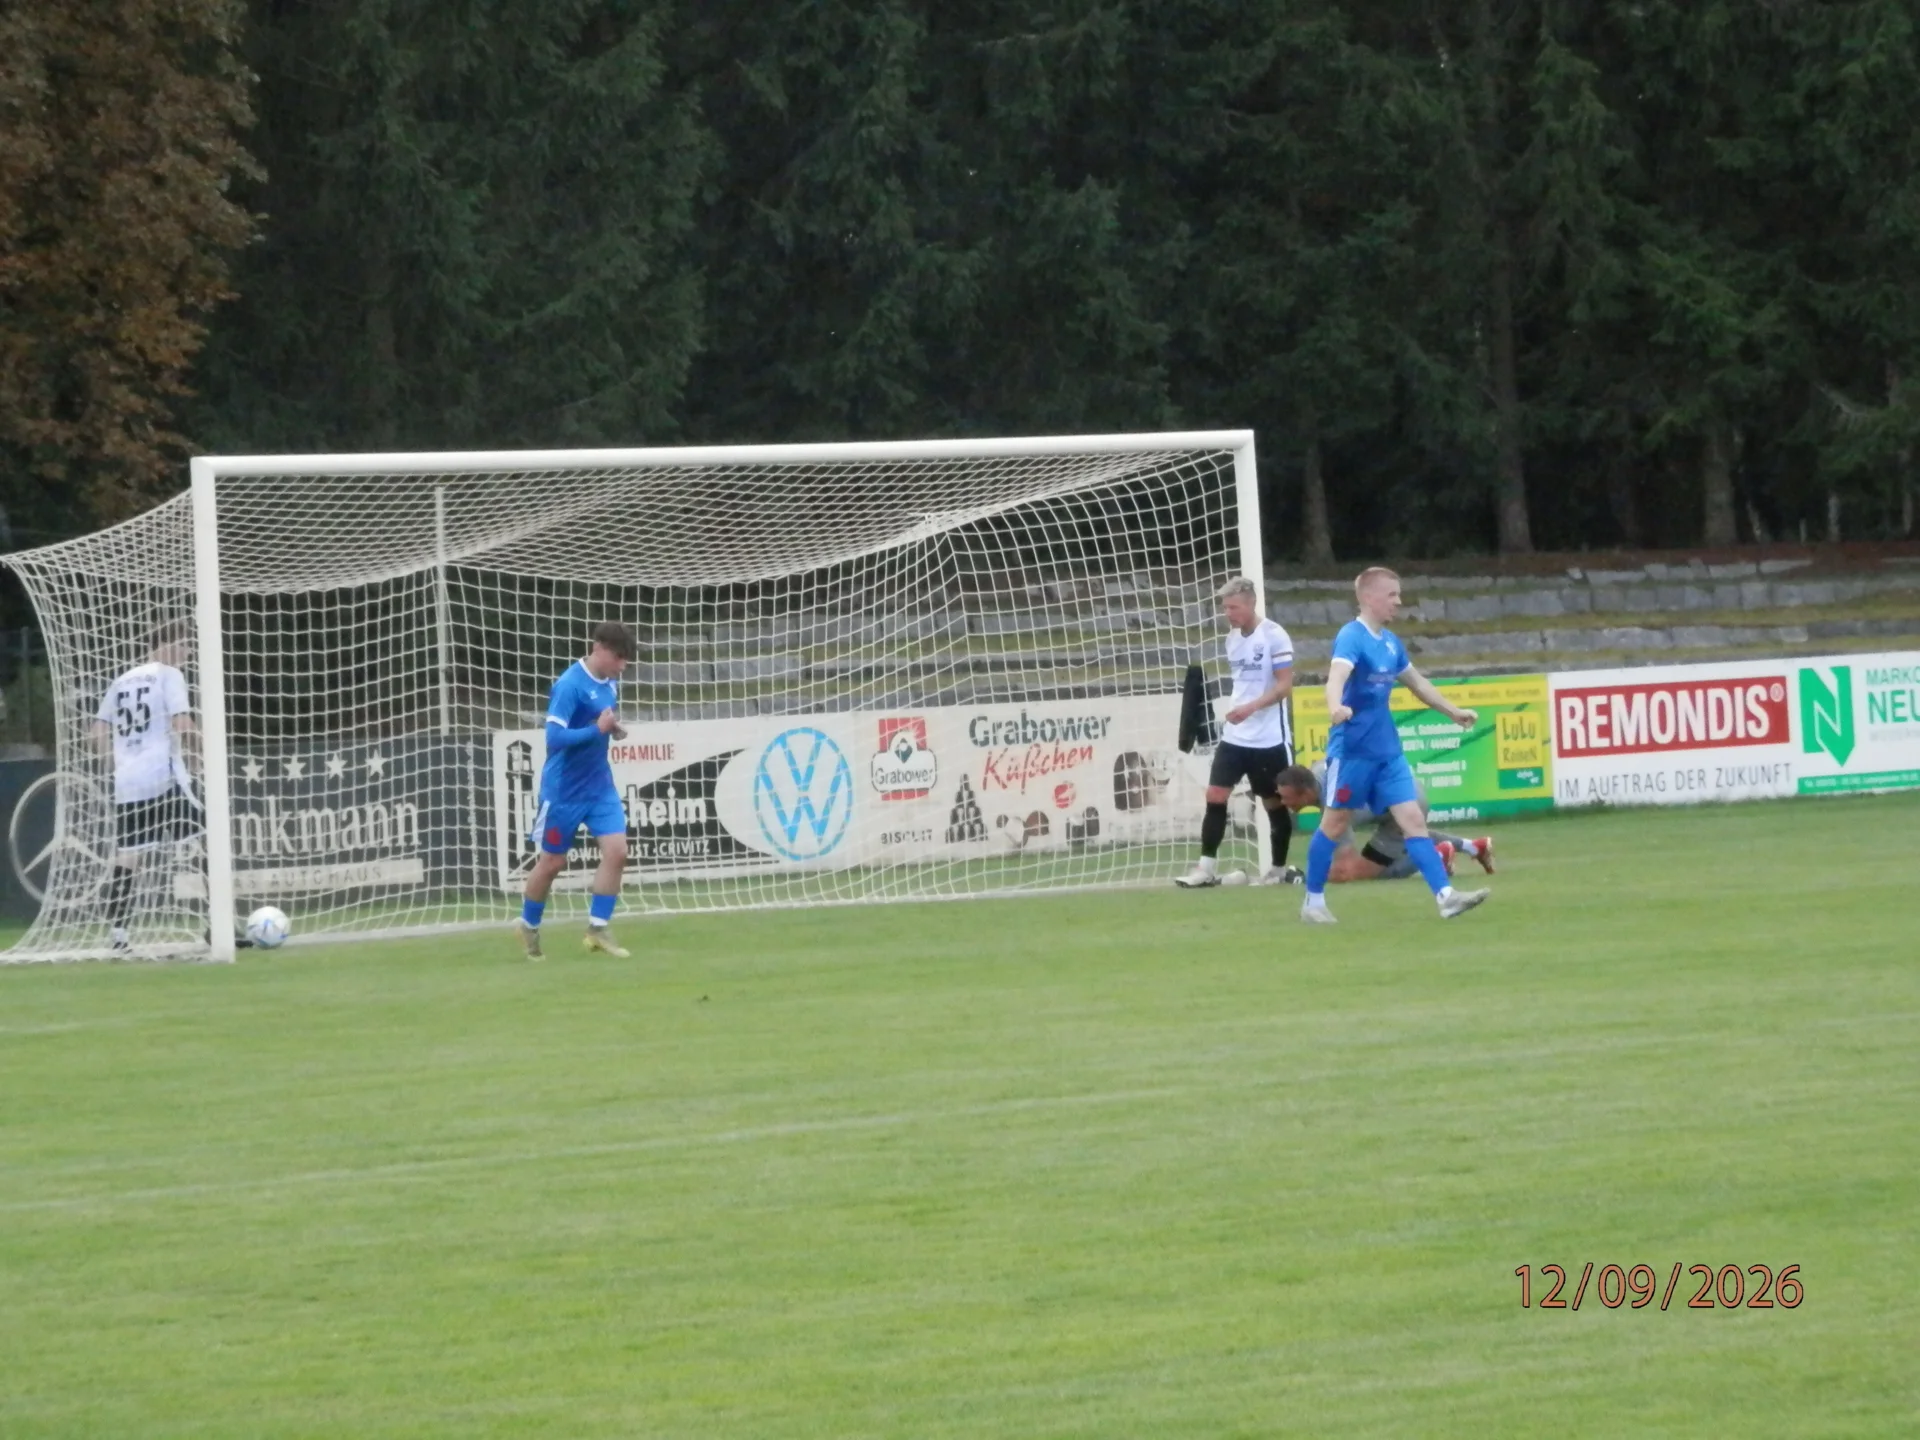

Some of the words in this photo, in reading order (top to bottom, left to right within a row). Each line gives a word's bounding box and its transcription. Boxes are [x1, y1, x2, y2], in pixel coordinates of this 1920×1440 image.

[117, 687, 150, 737] 55
[969, 708, 1111, 747] Grabower
[610, 743, 675, 765] OFAMILIE
[982, 739, 1093, 794] Küßchen
[875, 766, 934, 785] Grabower
[1559, 778, 1579, 799] IM
[1587, 770, 1667, 798] AUFTRAG
[1675, 767, 1707, 790] DER
[1715, 762, 1792, 789] ZUKUNFT
[234, 795, 422, 858] nkmann
